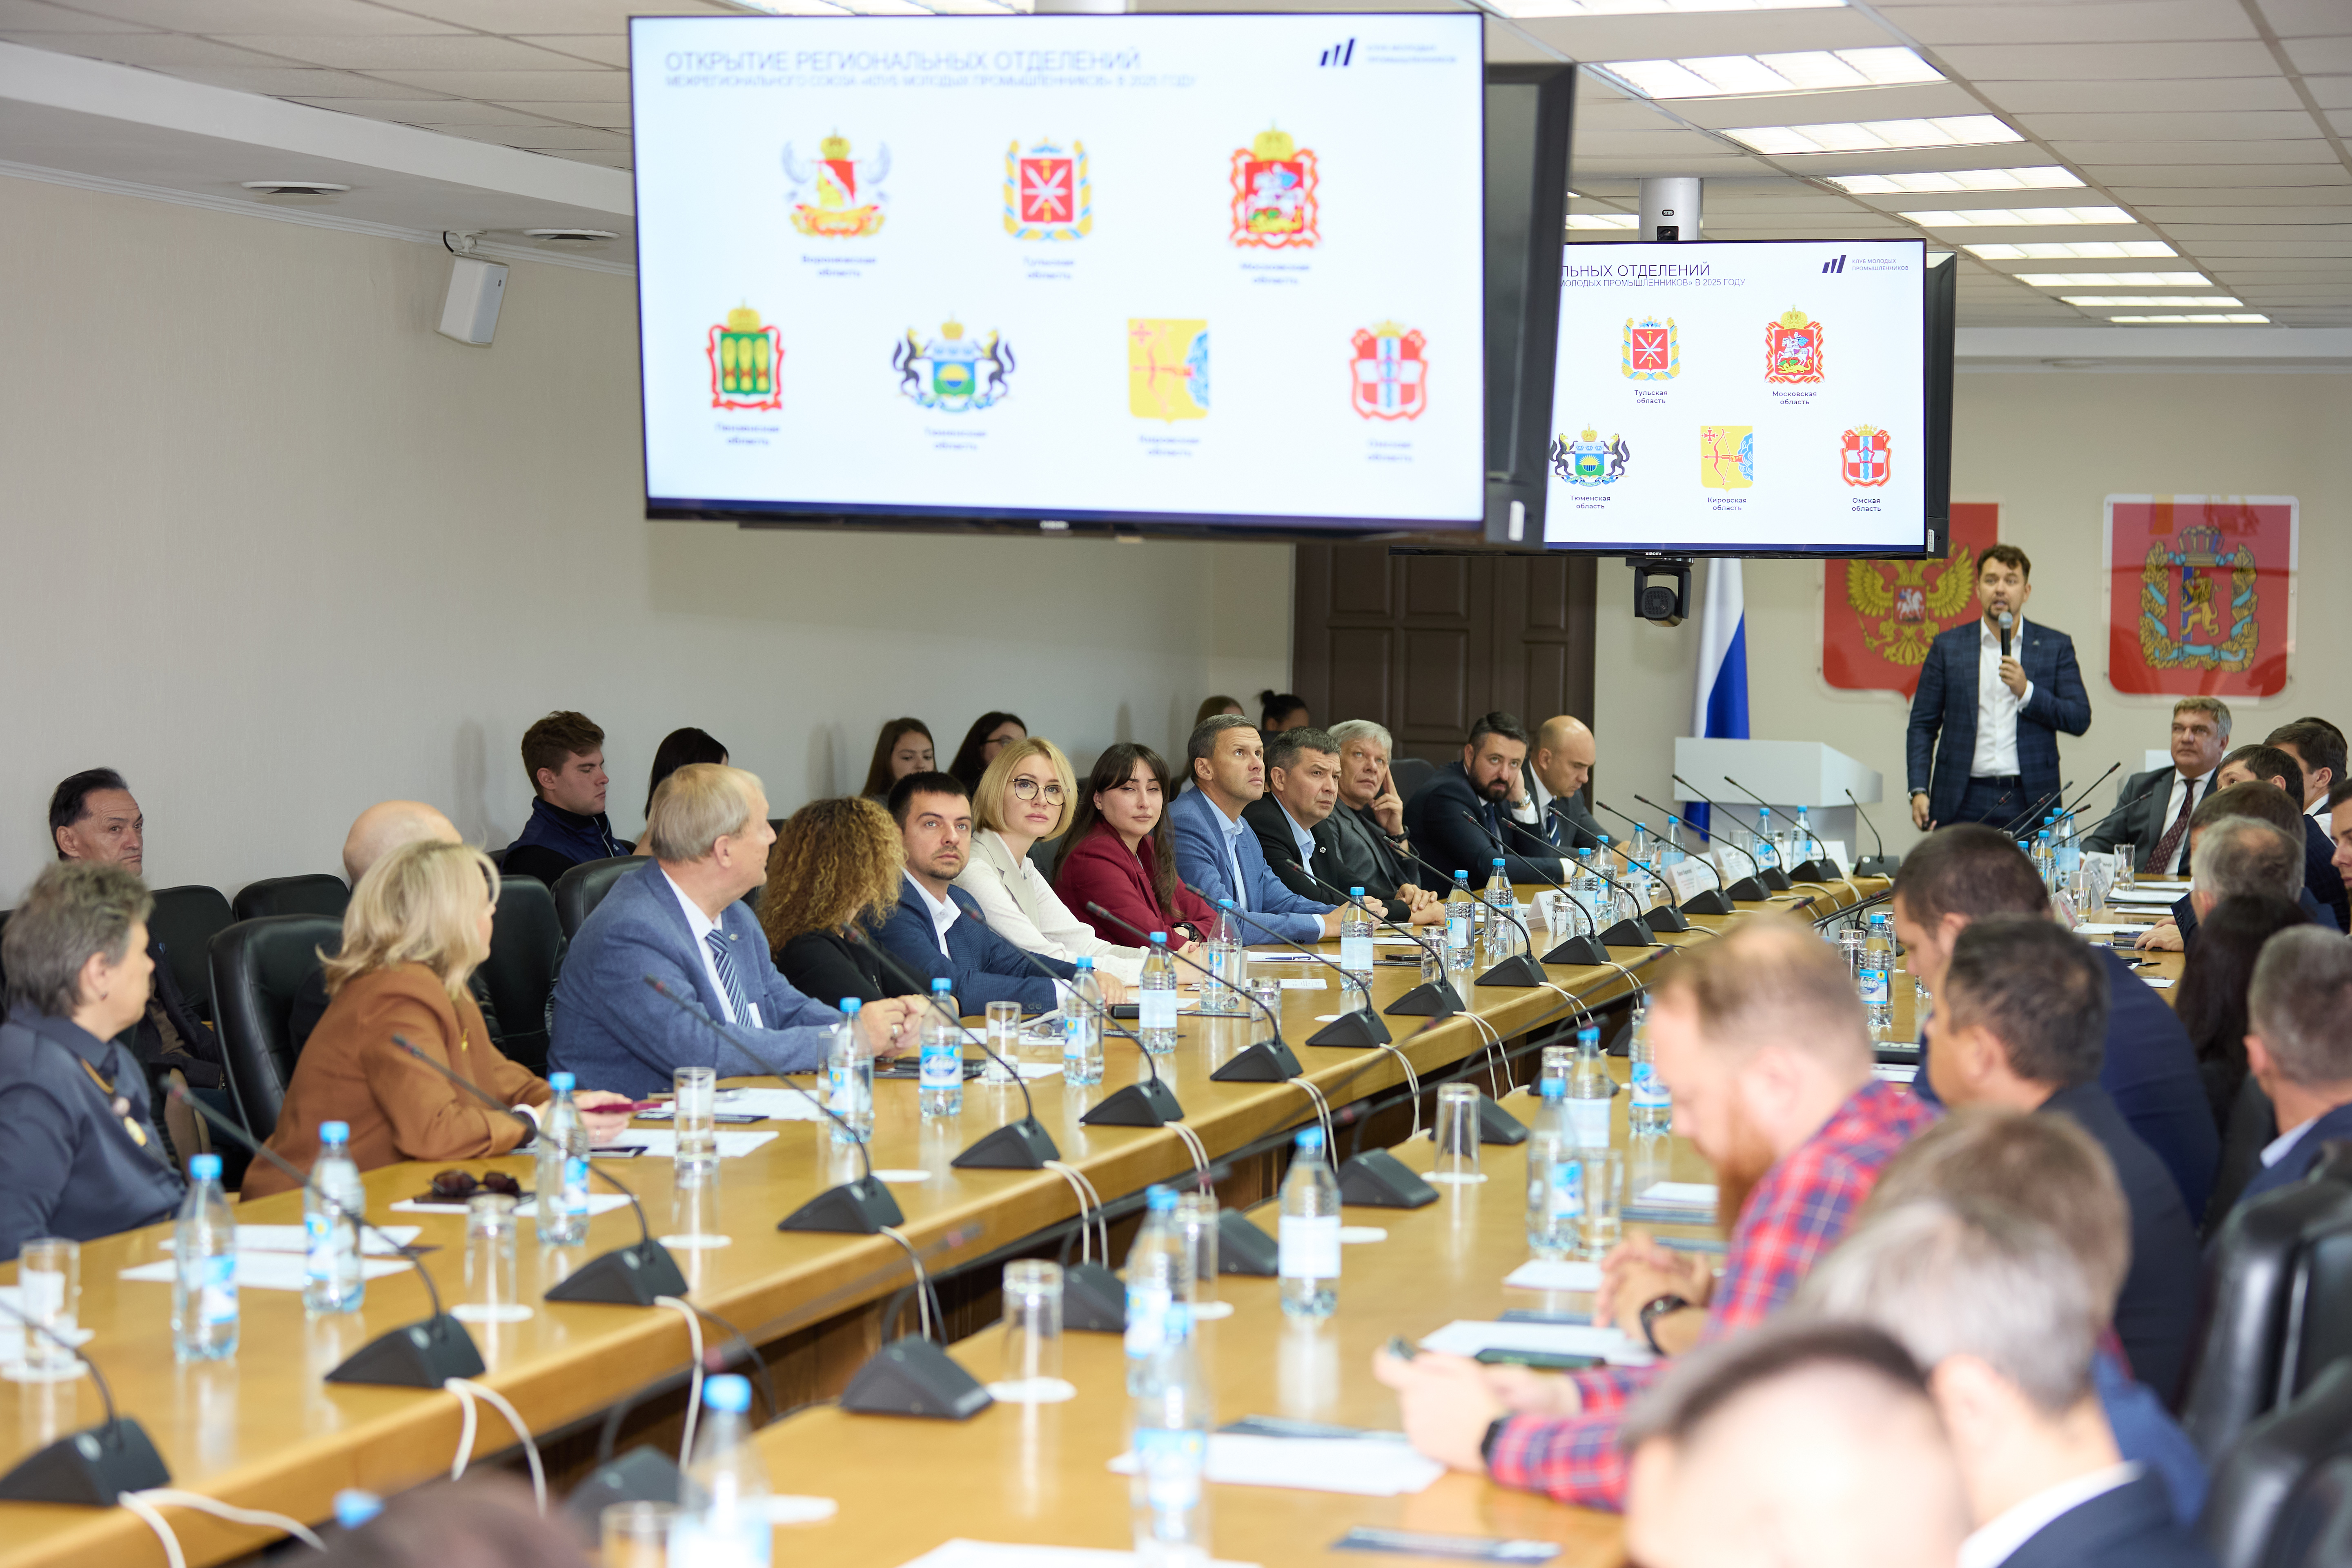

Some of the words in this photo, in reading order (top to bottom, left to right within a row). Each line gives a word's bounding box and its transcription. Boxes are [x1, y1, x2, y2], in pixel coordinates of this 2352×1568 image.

[665, 51, 789, 71] ОТКРЫТИЕ
[795, 51, 987, 71] РЕГИОНАЛЬНЫХ
[994, 46, 1140, 72] ОТДЕЛЕНИЙ
[1562, 265, 1613, 277] ЛЬНЫХ
[1617, 261, 1710, 278] ОТДЕЛЕНИЙ
[1604, 279, 1693, 287] ПРОМЫШЛЕННИКОВ»
[1724, 278, 1746, 287] ГОДУ
